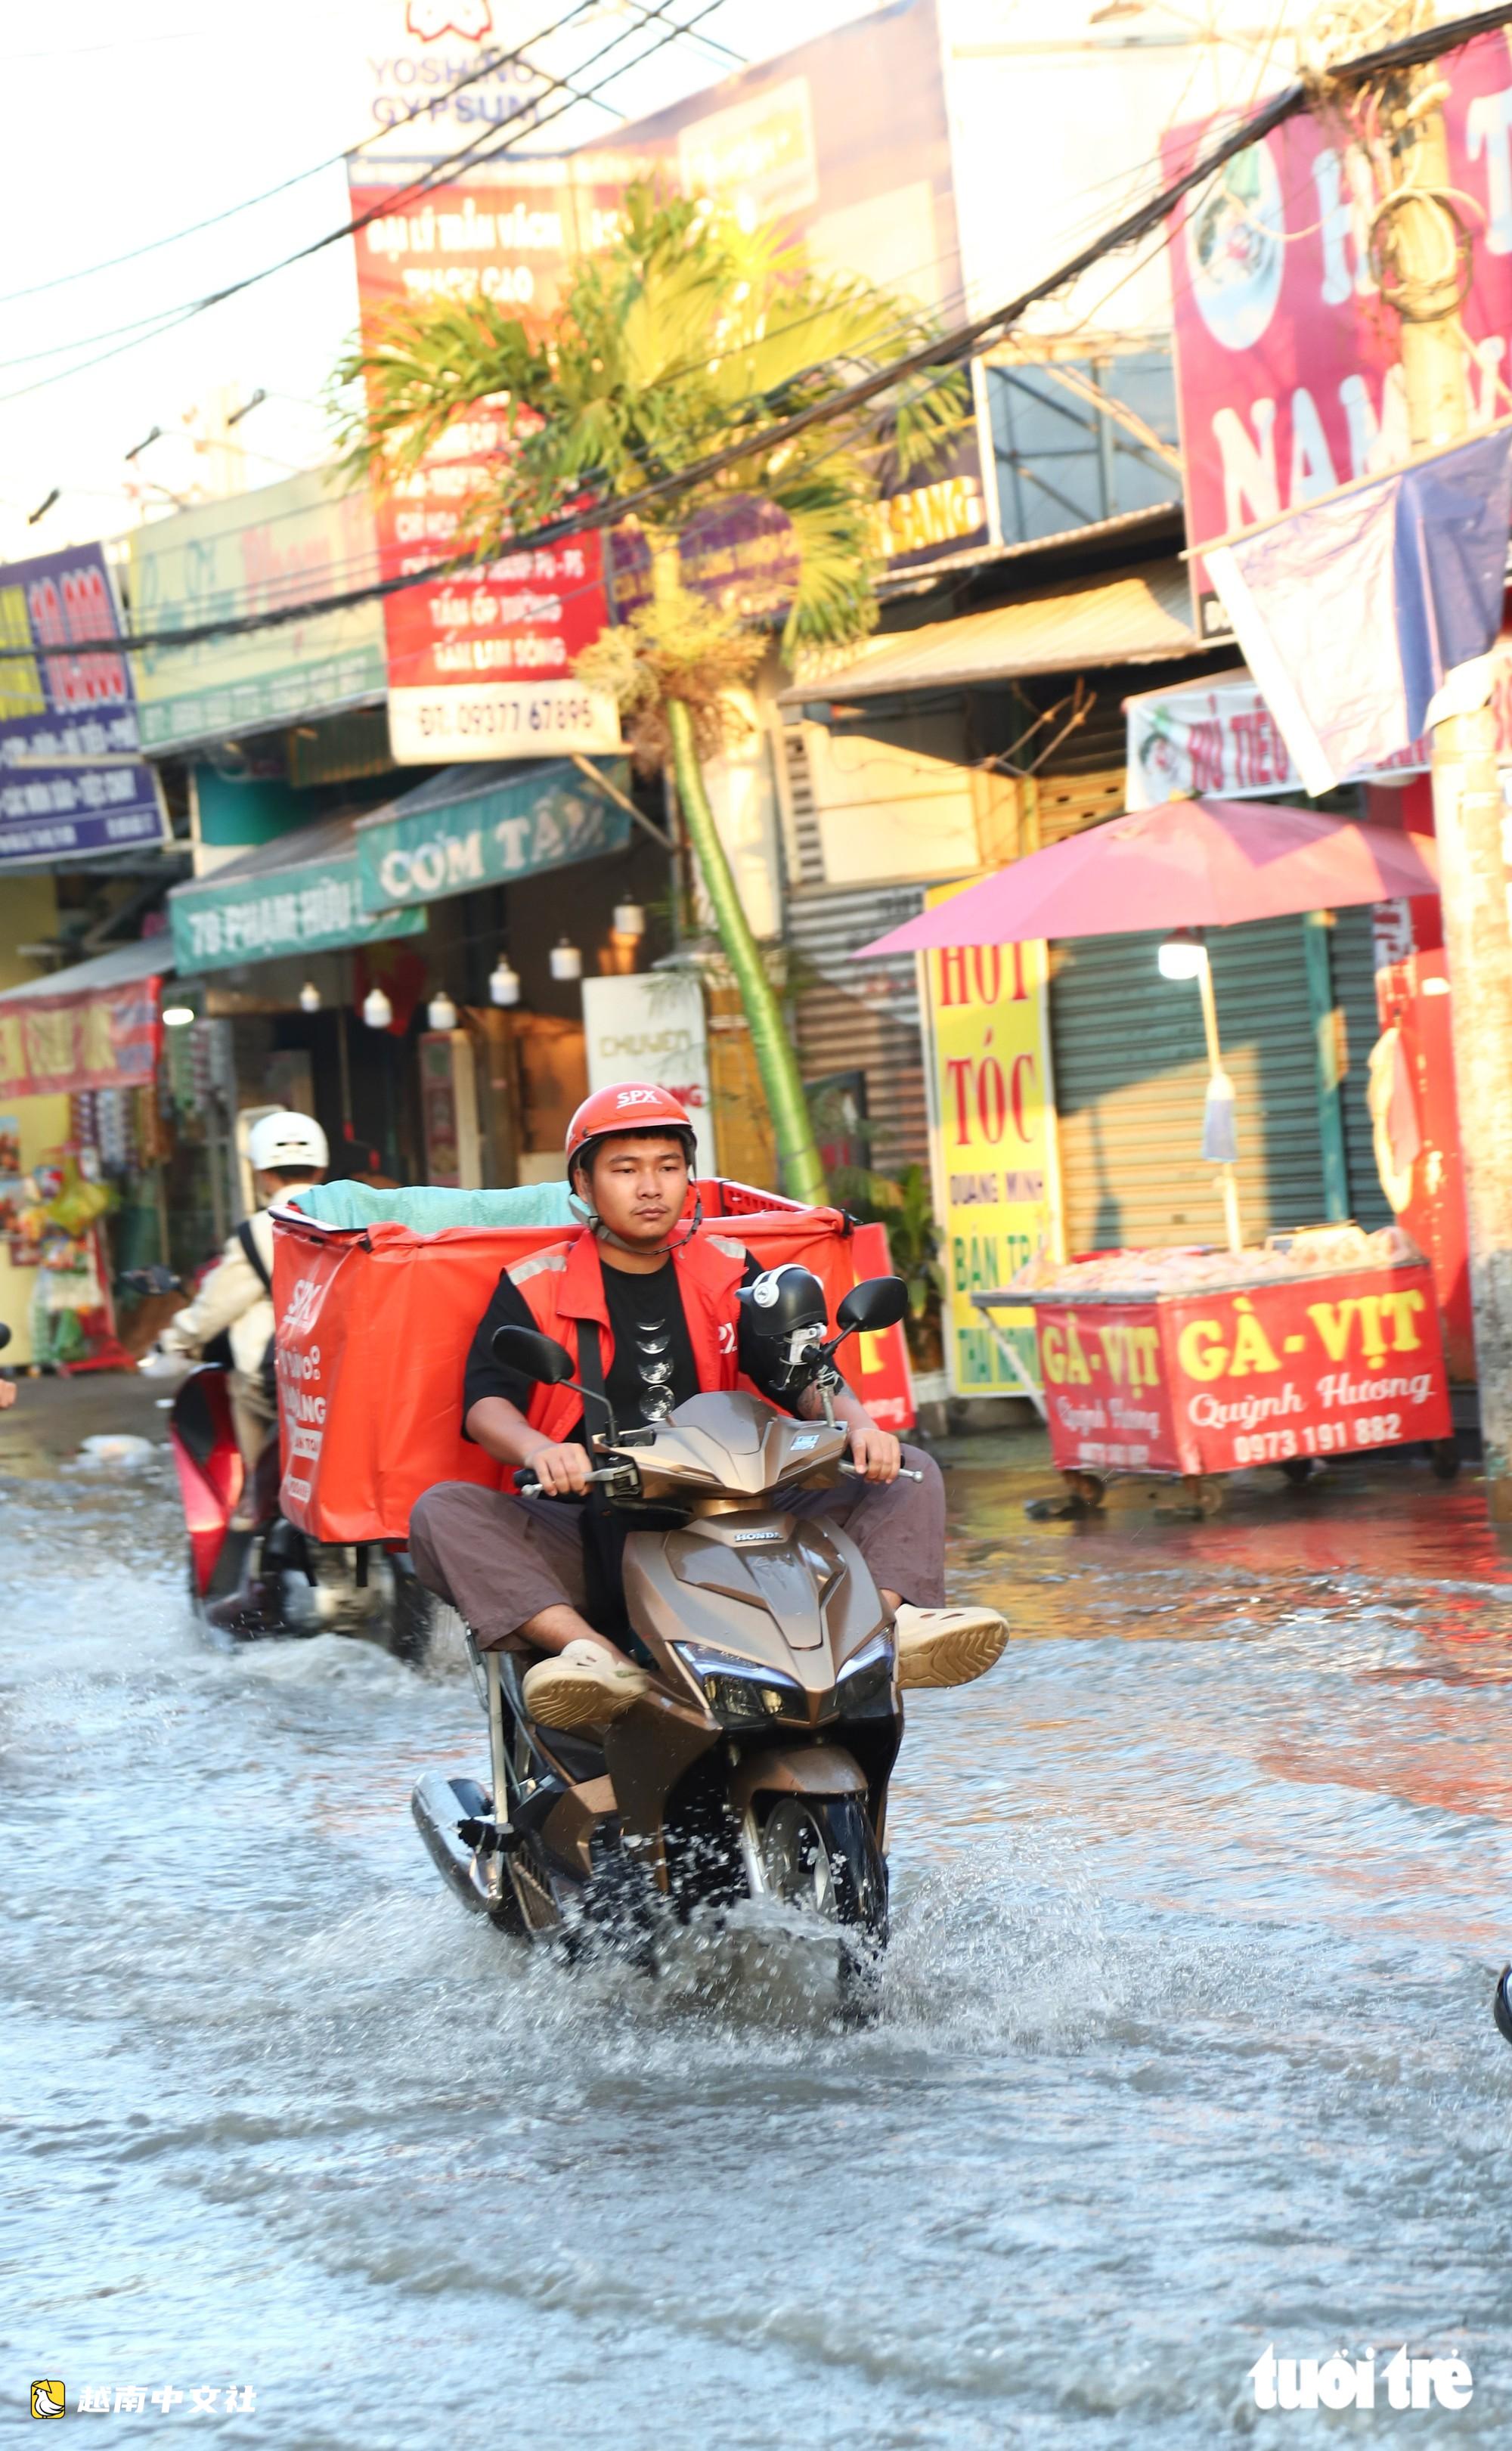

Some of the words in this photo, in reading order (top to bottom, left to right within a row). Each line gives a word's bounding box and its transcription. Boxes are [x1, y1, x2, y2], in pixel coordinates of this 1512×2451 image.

[380, 830, 485, 898] CƠM
[616, 1089, 658, 1105] SPX
[946, 1027, 1036, 1146] TÓC
[1188, 1382, 1307, 1431] Quỳnh
[1315, 1372, 1437, 1410] Hương
[1233, 1429, 1298, 1464] 0973
[1301, 1421, 1347, 1453] 191
[1354, 1412, 1402, 1445] 882
[735, 1530, 783, 1543] HONDA
